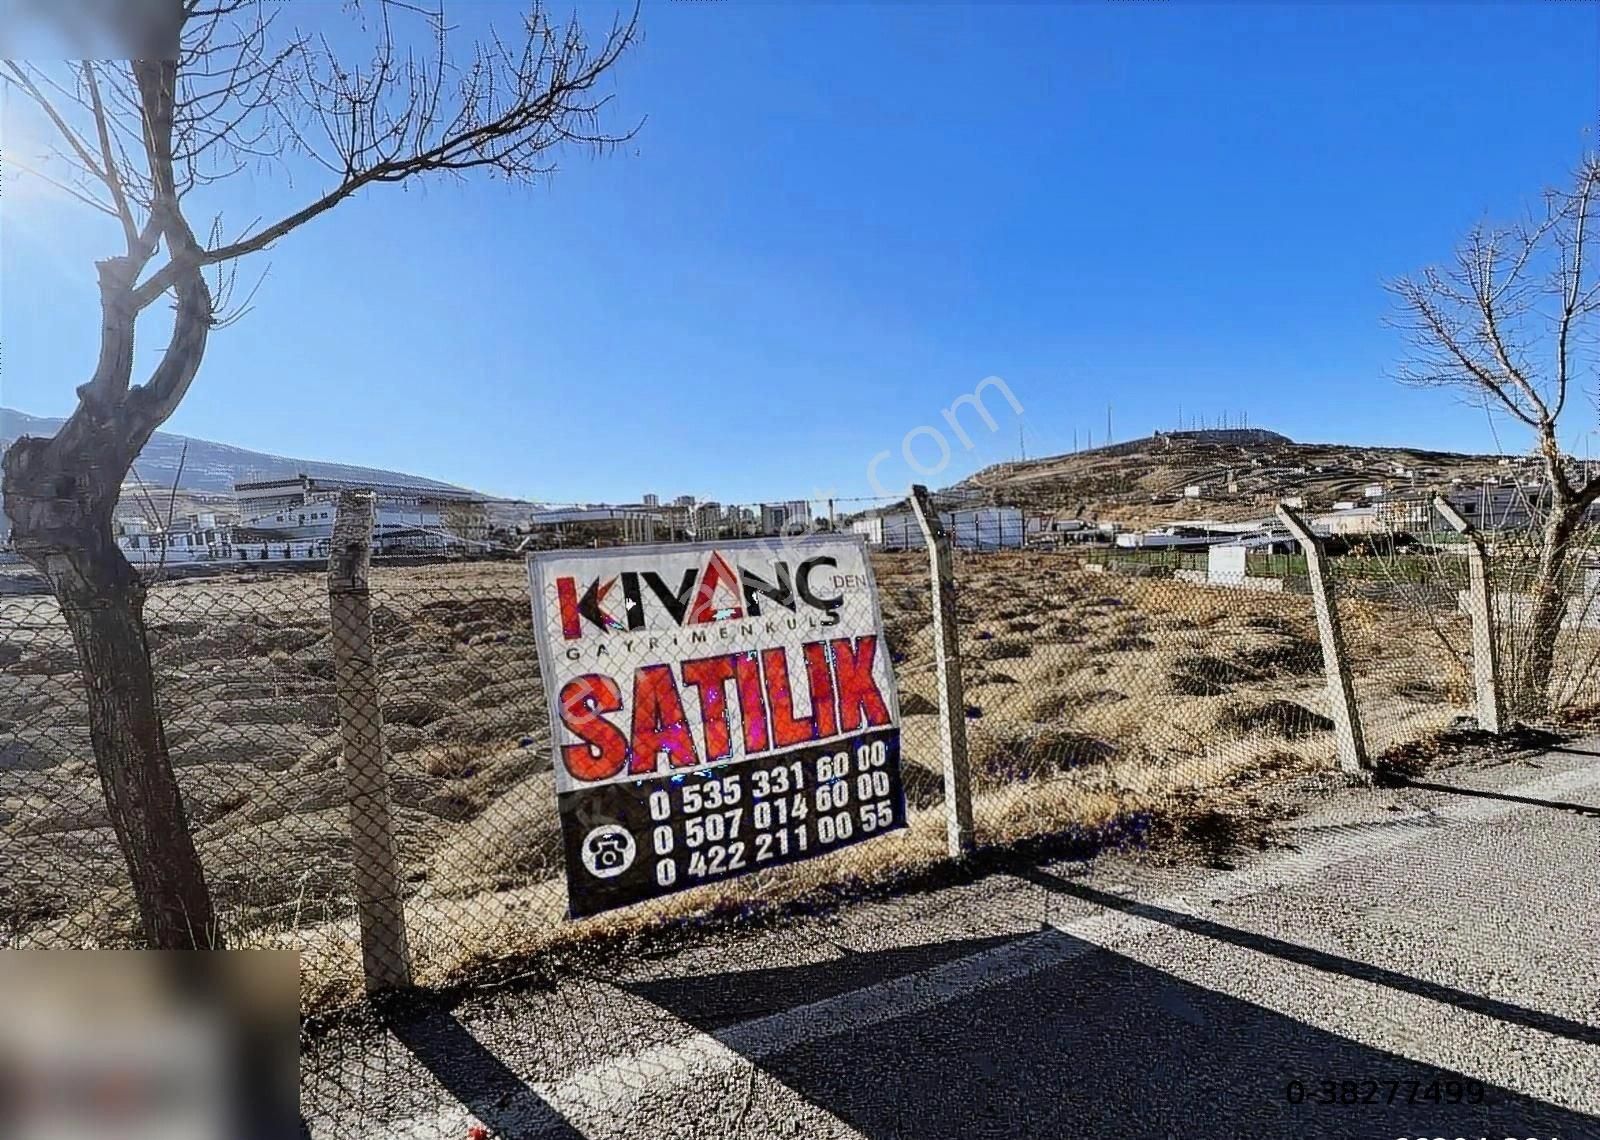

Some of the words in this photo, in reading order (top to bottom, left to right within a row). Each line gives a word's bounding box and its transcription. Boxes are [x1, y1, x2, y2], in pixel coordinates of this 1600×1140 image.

[558, 634, 892, 783] SATILIK
[649, 790, 671, 821] 0
[682, 775, 741, 814] 535
[751, 761, 804, 798] 331
[816, 752, 849, 782] 60
[857, 740, 886, 771] 00
[653, 825, 674, 855] 0
[685, 808, 743, 847] 507
[753, 793, 808, 829] 014
[816, 780, 849, 812] 60
[857, 771, 890, 800] 00
[656, 858, 677, 886] 0
[688, 841, 746, 877] 422
[755, 824, 808, 861] 211
[817, 811, 853, 843] 00
[860, 799, 893, 832] 55
